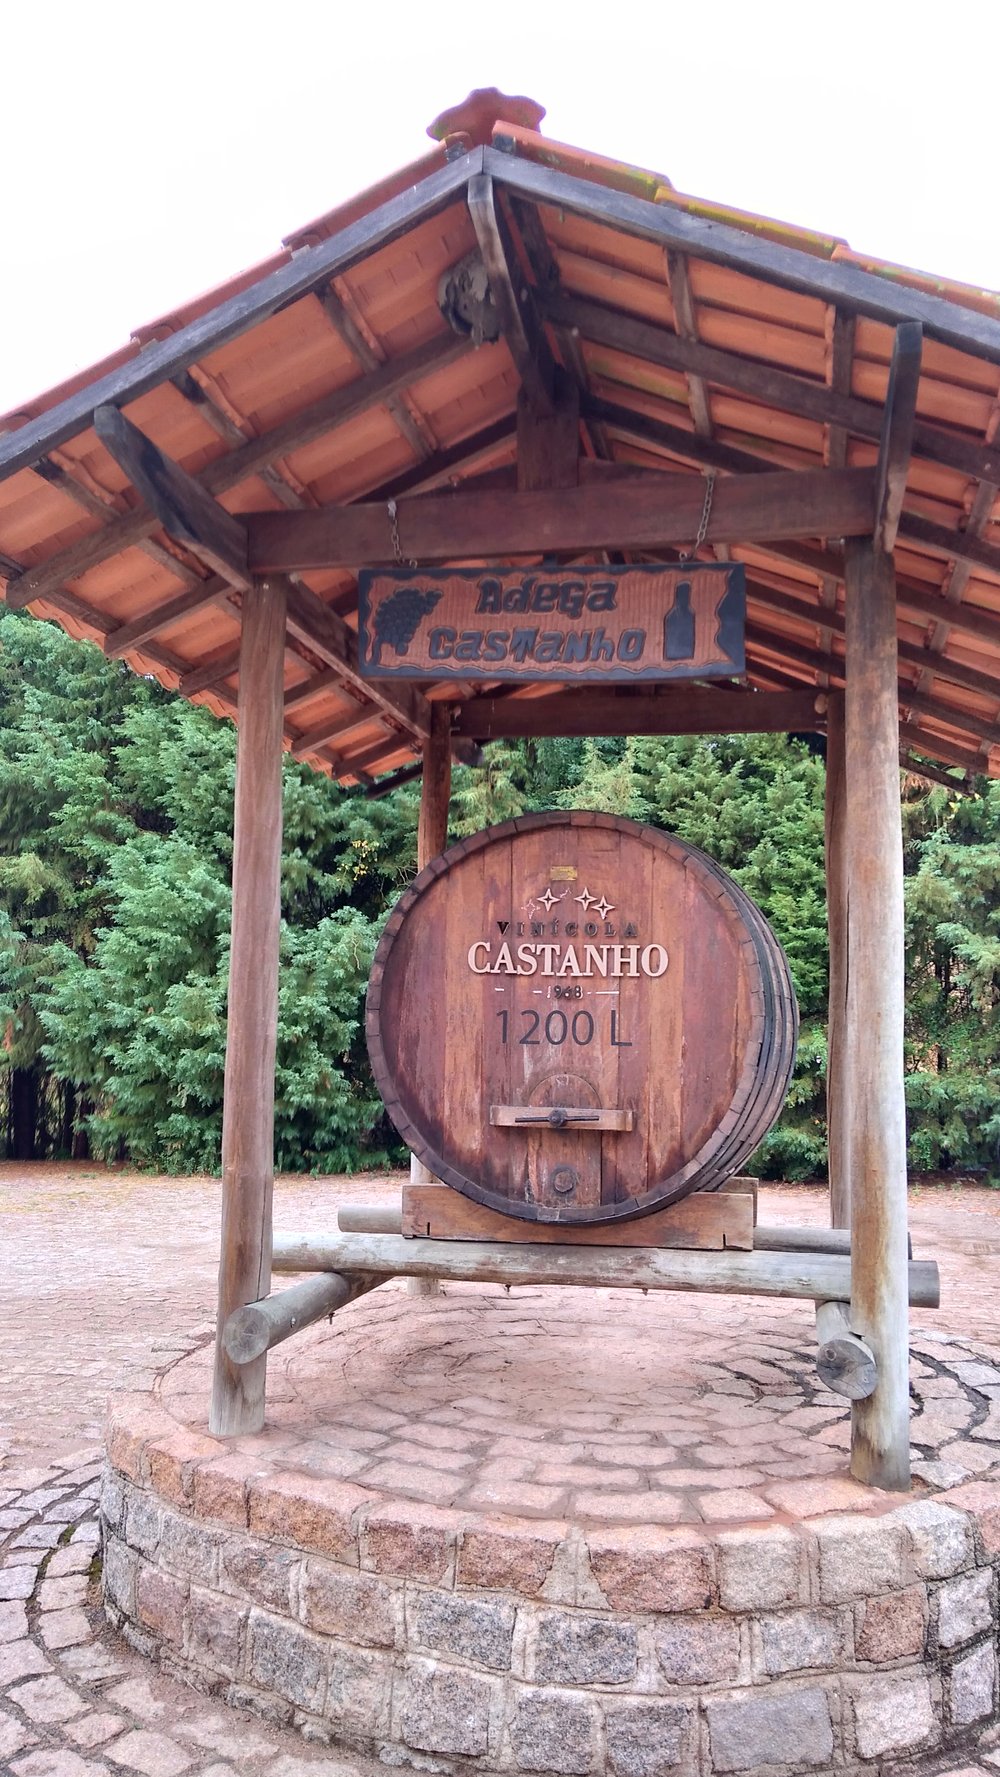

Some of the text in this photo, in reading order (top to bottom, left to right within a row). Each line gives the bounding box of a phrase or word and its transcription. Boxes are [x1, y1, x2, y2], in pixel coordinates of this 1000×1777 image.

[497, 919, 639, 937] VINÍCOLA
[467, 941, 669, 978] CASTANHO
[496, 1009, 633, 1047] 1200 L
